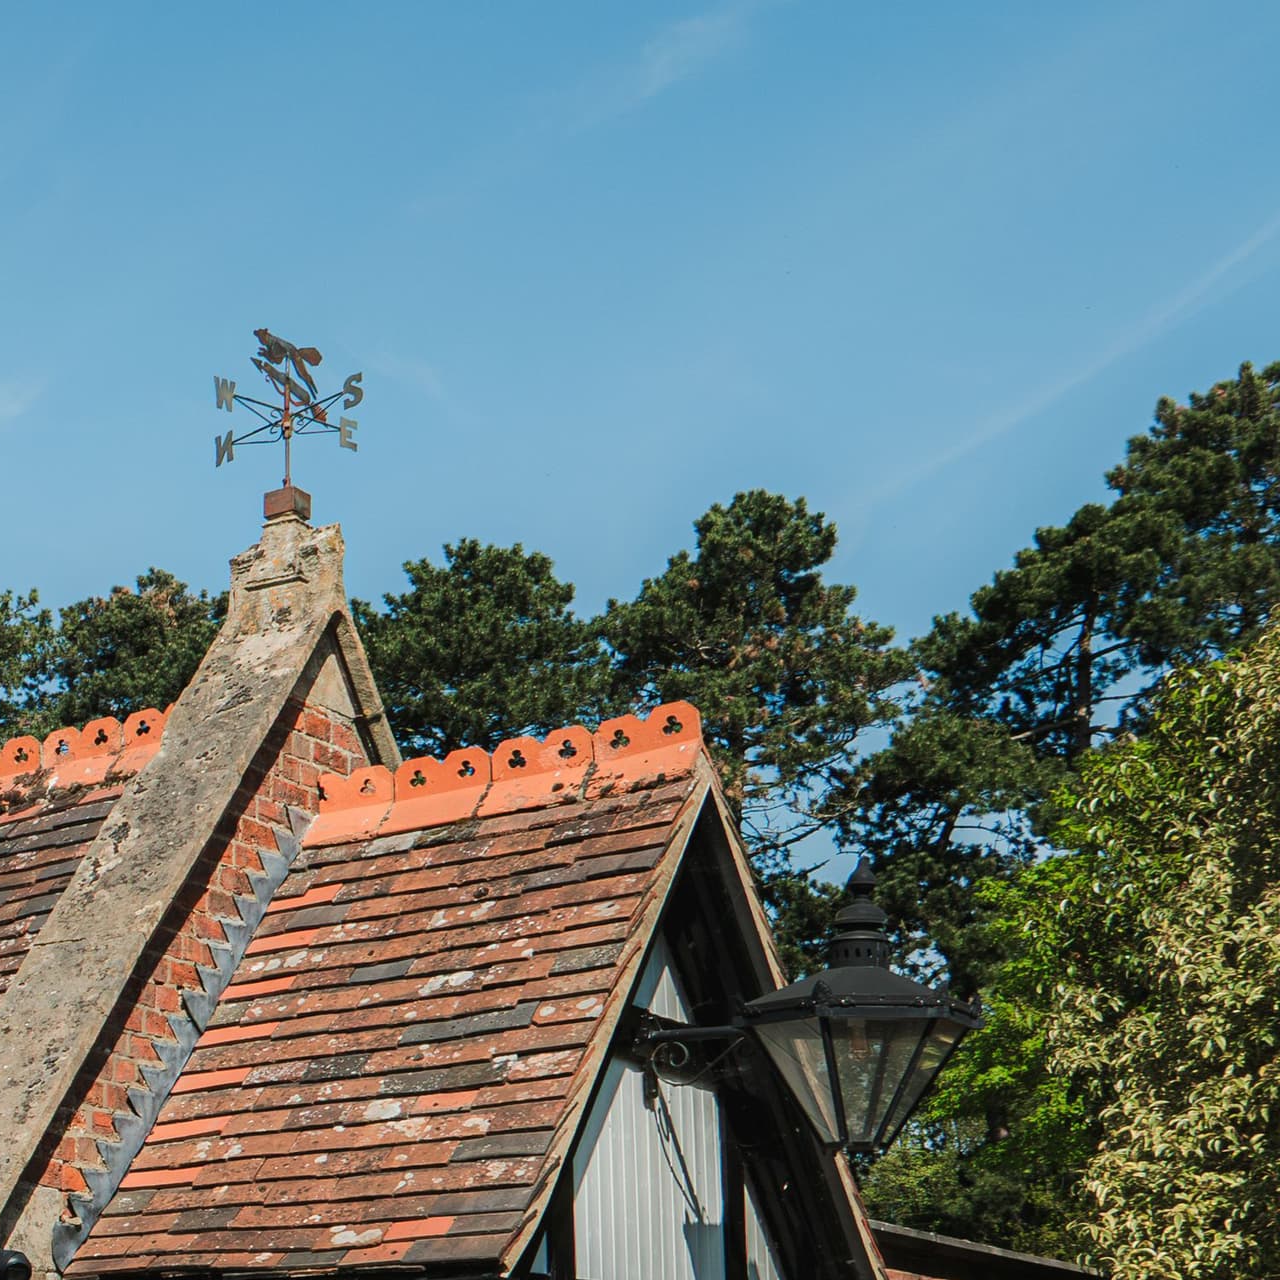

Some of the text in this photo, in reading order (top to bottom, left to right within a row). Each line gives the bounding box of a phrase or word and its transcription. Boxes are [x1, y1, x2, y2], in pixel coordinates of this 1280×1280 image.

[214, 376, 236, 412] W
[343, 372, 363, 410] S
[340, 416, 358, 452] E
